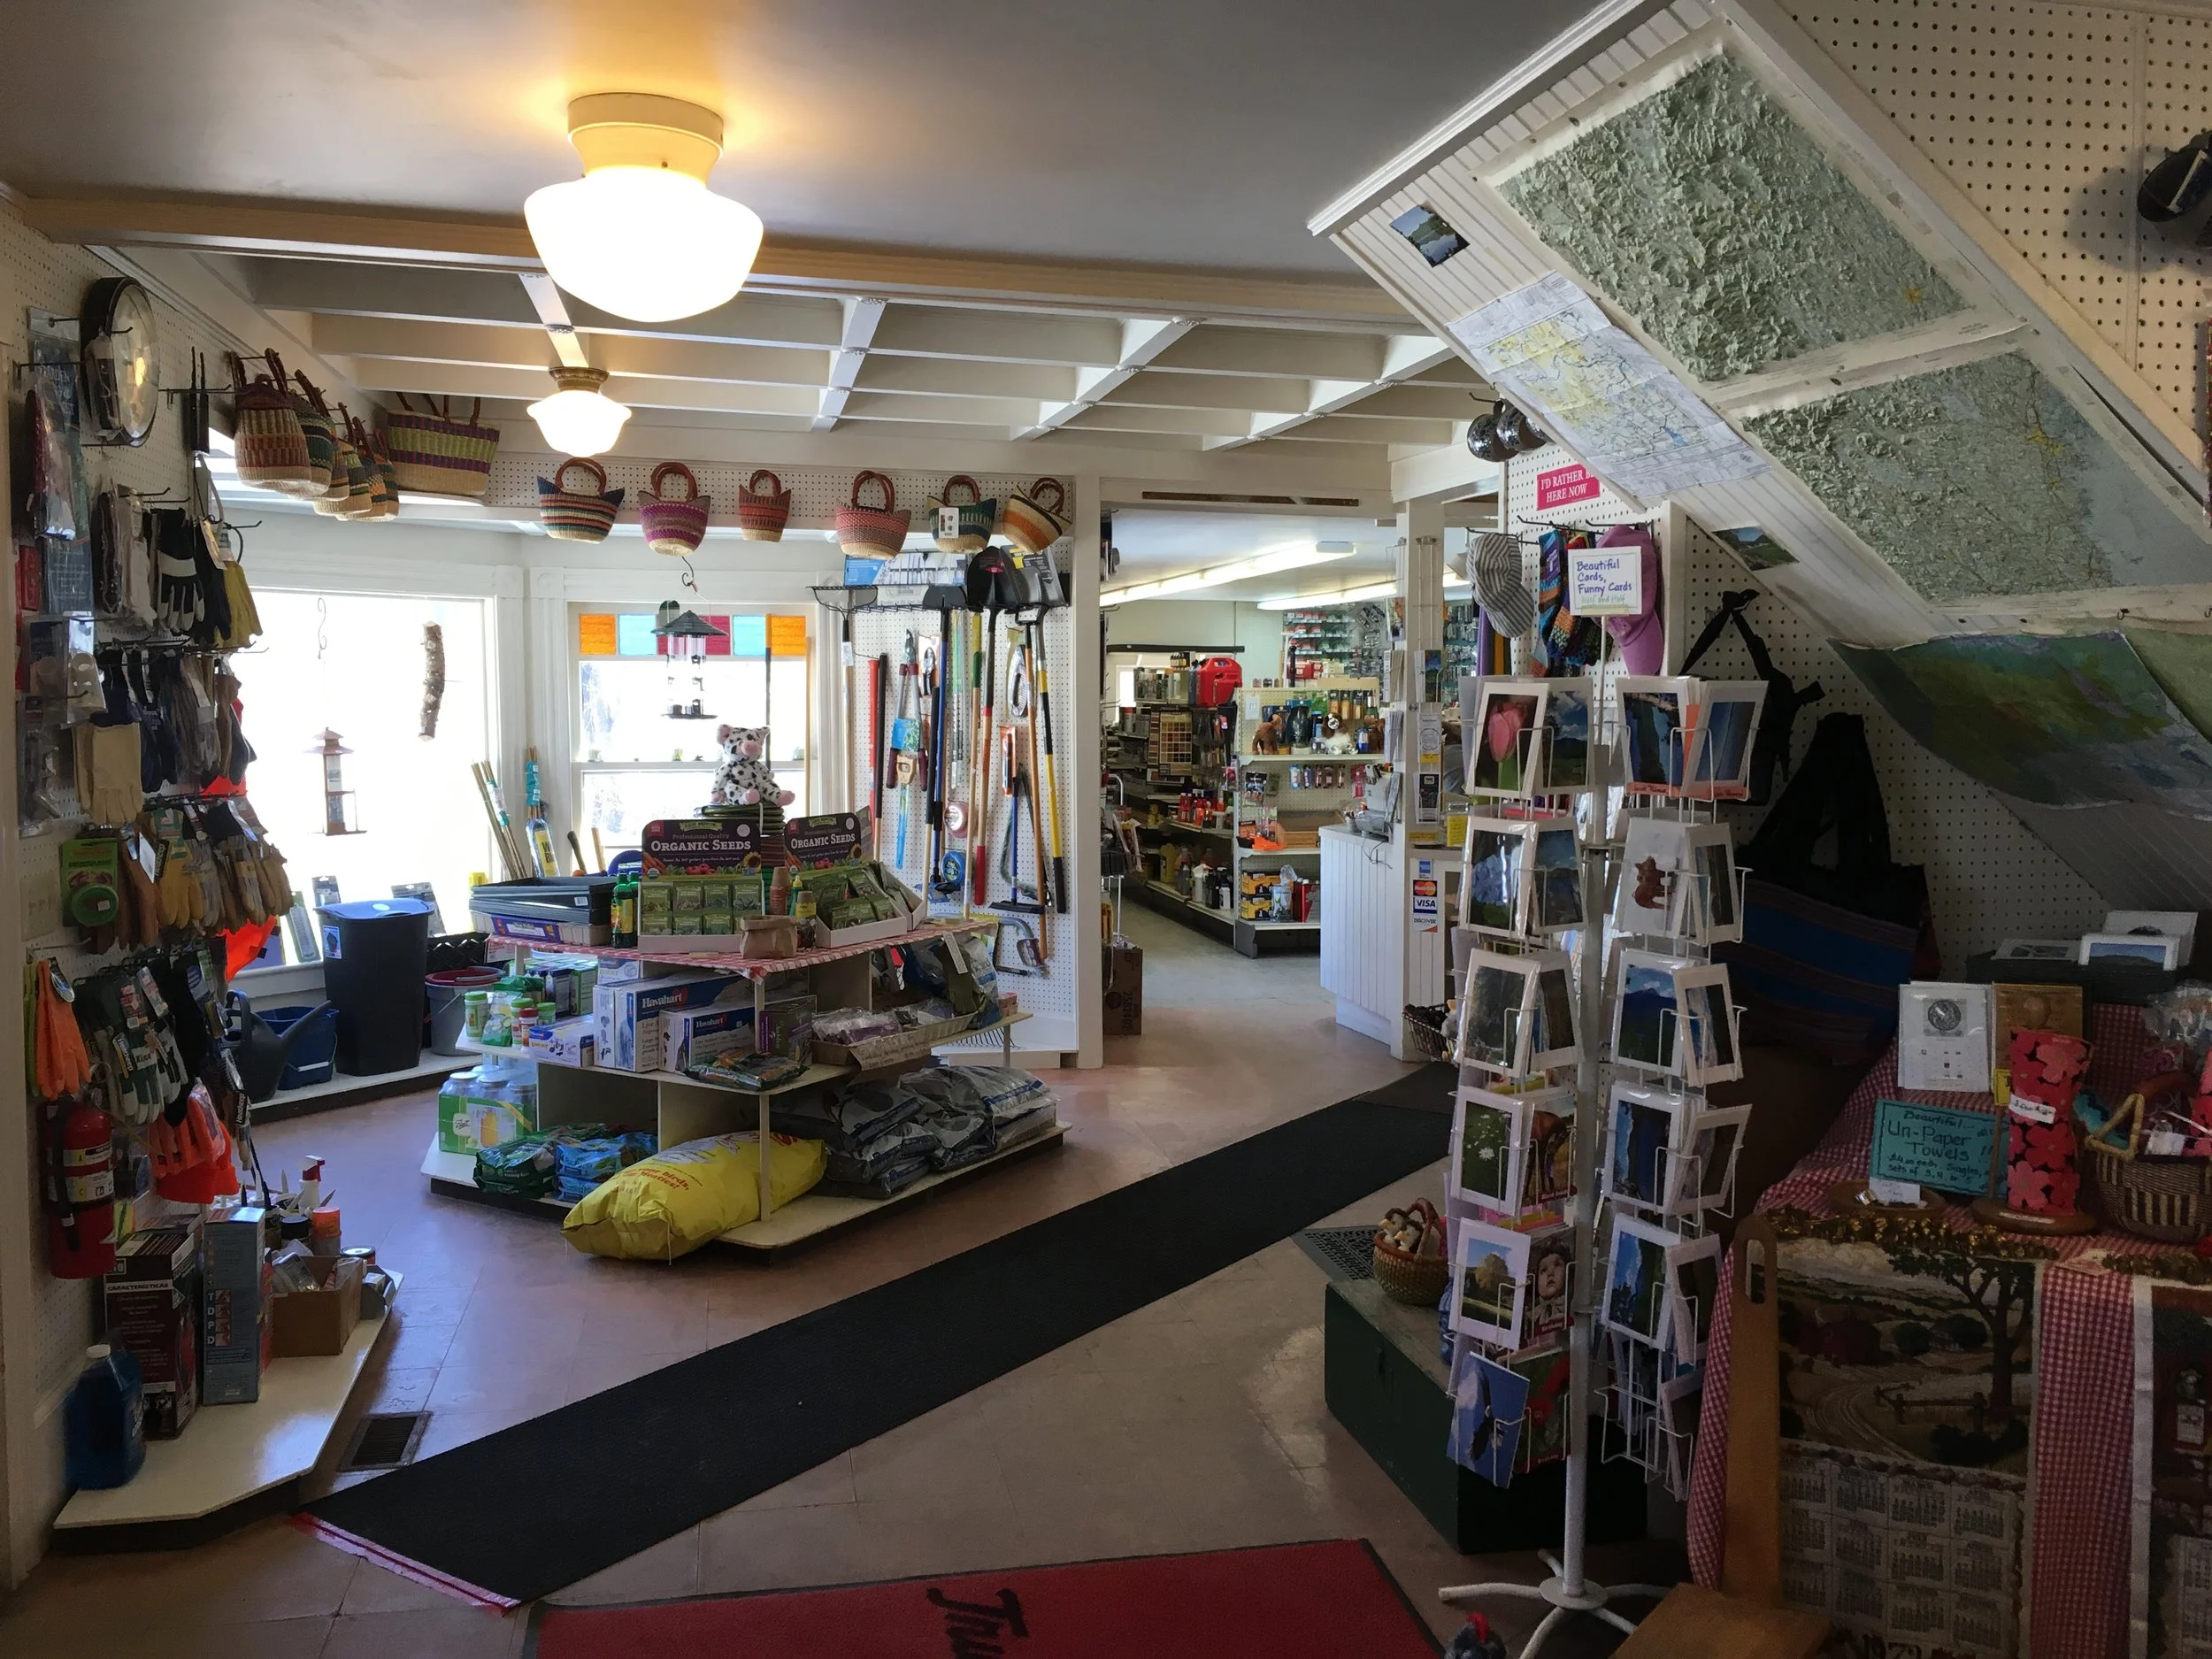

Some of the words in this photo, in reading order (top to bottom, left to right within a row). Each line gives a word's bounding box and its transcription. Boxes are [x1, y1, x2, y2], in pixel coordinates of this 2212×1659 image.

[1540, 479, 1551, 490] I'D
[1553, 470, 1584, 487] RATHER
[1546, 488, 1567, 503] HERE
[1568, 483, 1588, 498] NOW
[1577, 558, 1620, 571] Beautiful
[1578, 572, 1607, 583] Cards,
[1578, 583, 1606, 597] Funny
[1609, 581, 1632, 592] Cards
[650, 841, 710, 852] ORGANIC
[712, 840, 751, 850] SEEDS
[791, 837, 829, 849] ORGANIC
[831, 833, 856, 844] SEEDS
[1417, 899, 1435, 908] VISA
[641, 993, 683, 1009] Havahart
[695, 1017, 724, 1028] Havahart
[1888, 1119, 1971, 1149] Un-Paper
[1905, 1141, 1970, 1161] Towels
[662, 1171, 691, 1191] birds,
